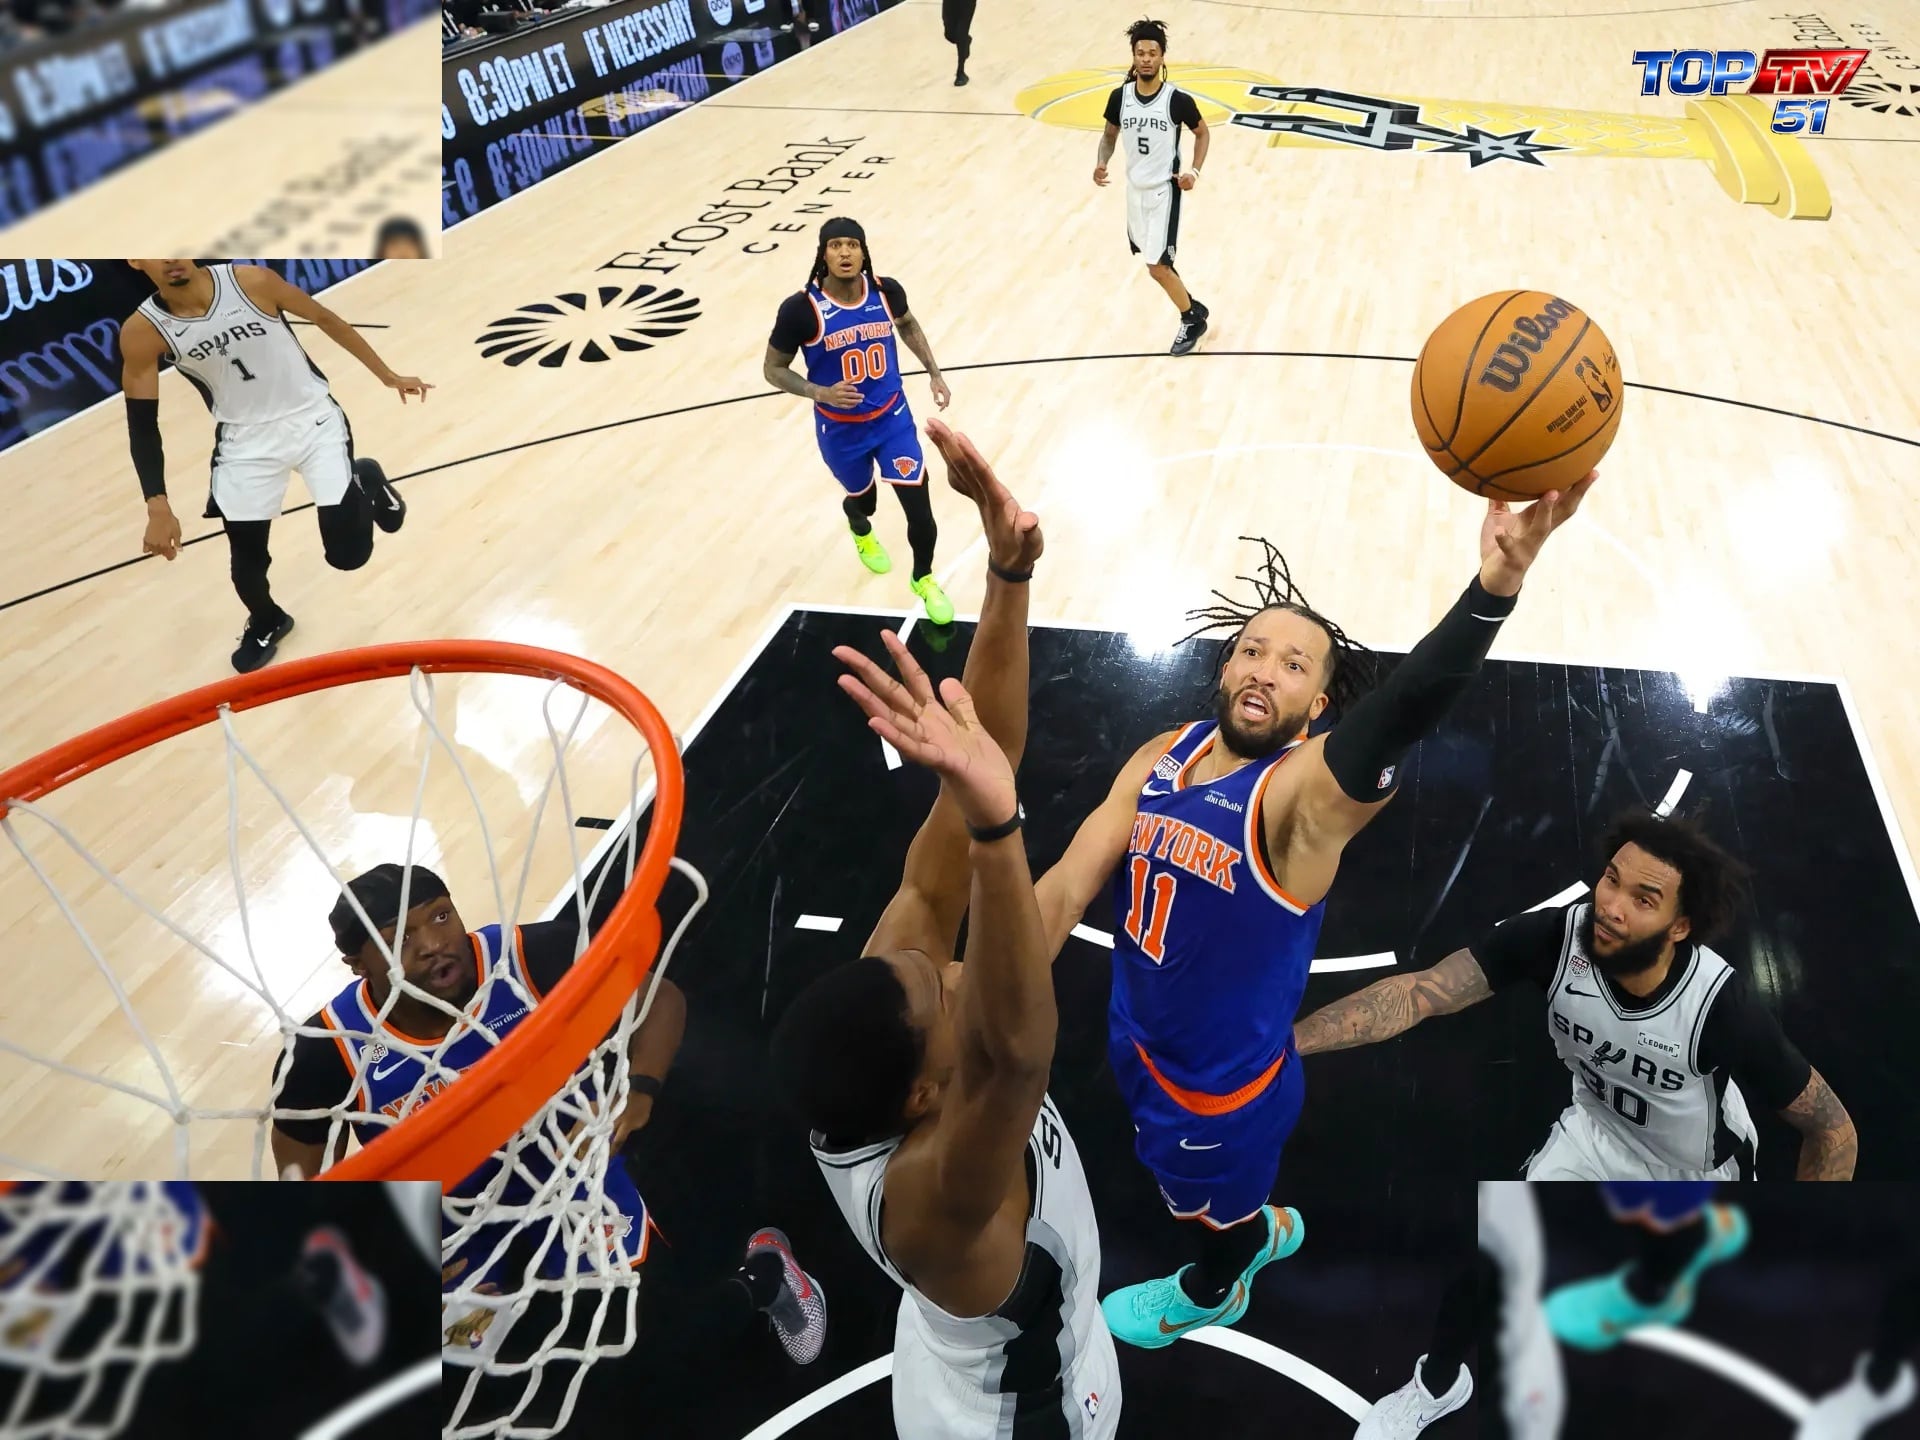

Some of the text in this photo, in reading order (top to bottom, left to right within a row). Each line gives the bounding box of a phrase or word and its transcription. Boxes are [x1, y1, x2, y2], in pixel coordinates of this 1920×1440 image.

[457, 52, 554, 126] 8:30PM
[543, 42, 576, 94] ET
[582, 27, 609, 77] IF
[601, 0, 697, 70] NECESSARY
[1122, 117, 1168, 132] SPURS
[1137, 137, 1150, 155] 5
[594, 136, 866, 275] Frost Bank
[742, 156, 896, 254] CENTER
[187, 322, 267, 361] SPURS
[824, 321, 893, 351] NEW YORK
[841, 342, 887, 384] 00
[1477, 297, 1580, 393] Wilson
[231, 358, 256, 381] 1
[1204, 793, 1218, 804] abu
[1218, 798, 1244, 814] dhabi
[1155, 816, 1243, 895] YORK
[1124, 854, 1177, 966] 11
[1553, 1011, 1686, 1091] SPURS
[1643, 1037, 1674, 1054] LEDGER
[1579, 1058, 1649, 1128] 30
